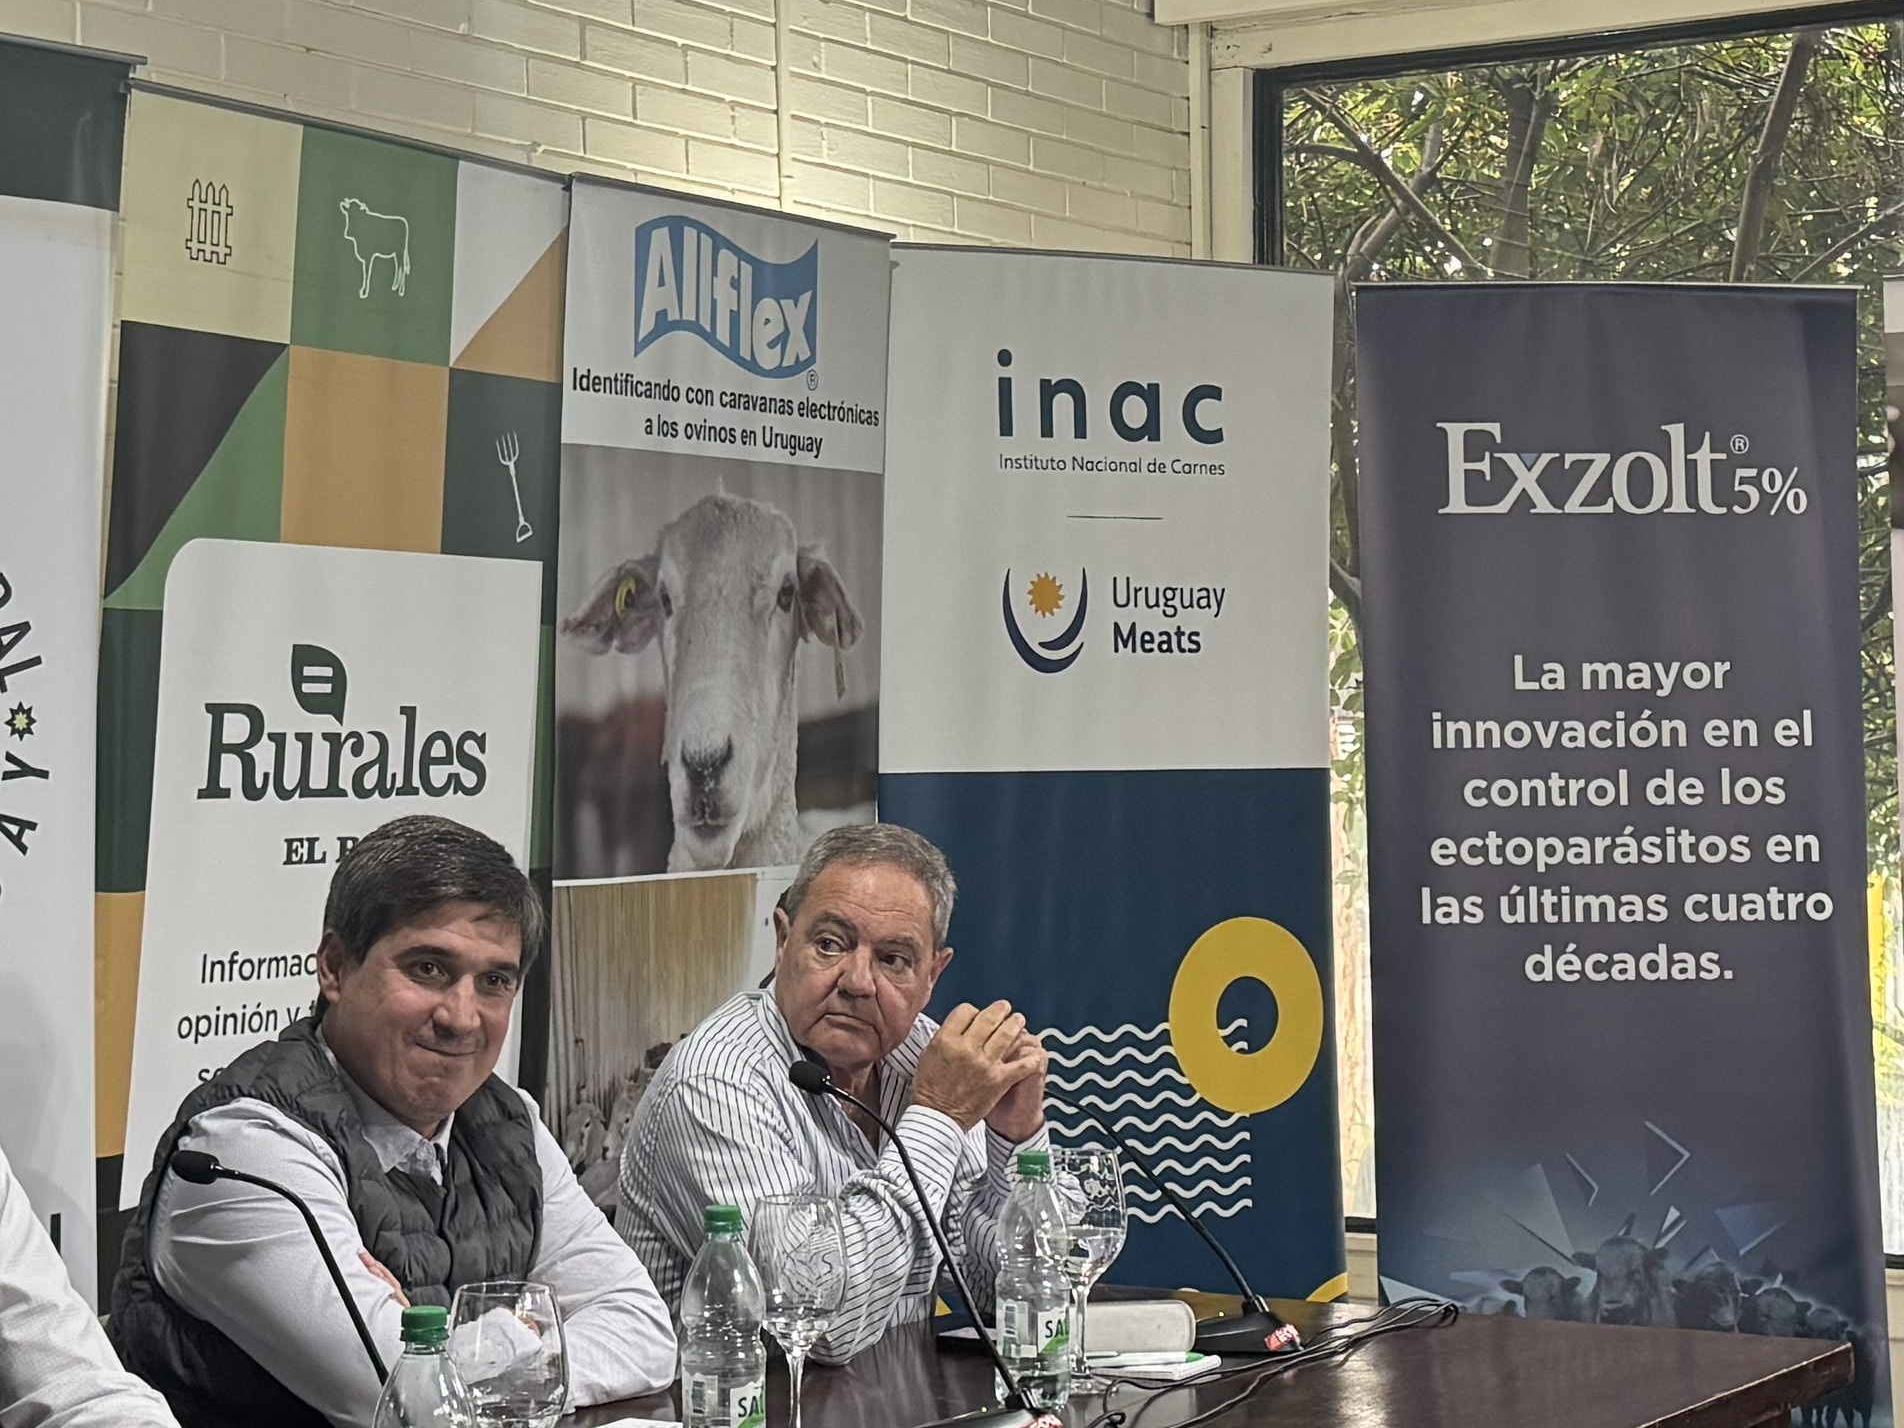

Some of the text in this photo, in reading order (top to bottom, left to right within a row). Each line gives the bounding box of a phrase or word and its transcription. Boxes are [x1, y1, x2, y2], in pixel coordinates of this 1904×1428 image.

[637, 225, 814, 371] Allflex
[572, 367, 880, 427] Identificando con caravanas electrónicas
[997, 348, 1224, 445] inac
[644, 414, 823, 459] a los ovinos en Uruguay
[999, 453, 1226, 476] Instituto Nacional de Carnes
[1732, 467, 1808, 516] 5%
[1112, 576, 1226, 618] Uruguay
[1113, 621, 1202, 654] Meats
[1513, 654, 1731, 697] La mayor
[1431, 709, 1813, 749] innovación en el
[197, 702, 487, 801] Rurales
[1463, 768, 1786, 807] control de los
[283, 837, 327, 865] EL
[1430, 825, 1820, 872] ectoparásitos en
[1421, 885, 1834, 924] las últimas cuatro
[1524, 943, 1733, 982] décadas.
[177, 1002, 278, 1044] opinión
